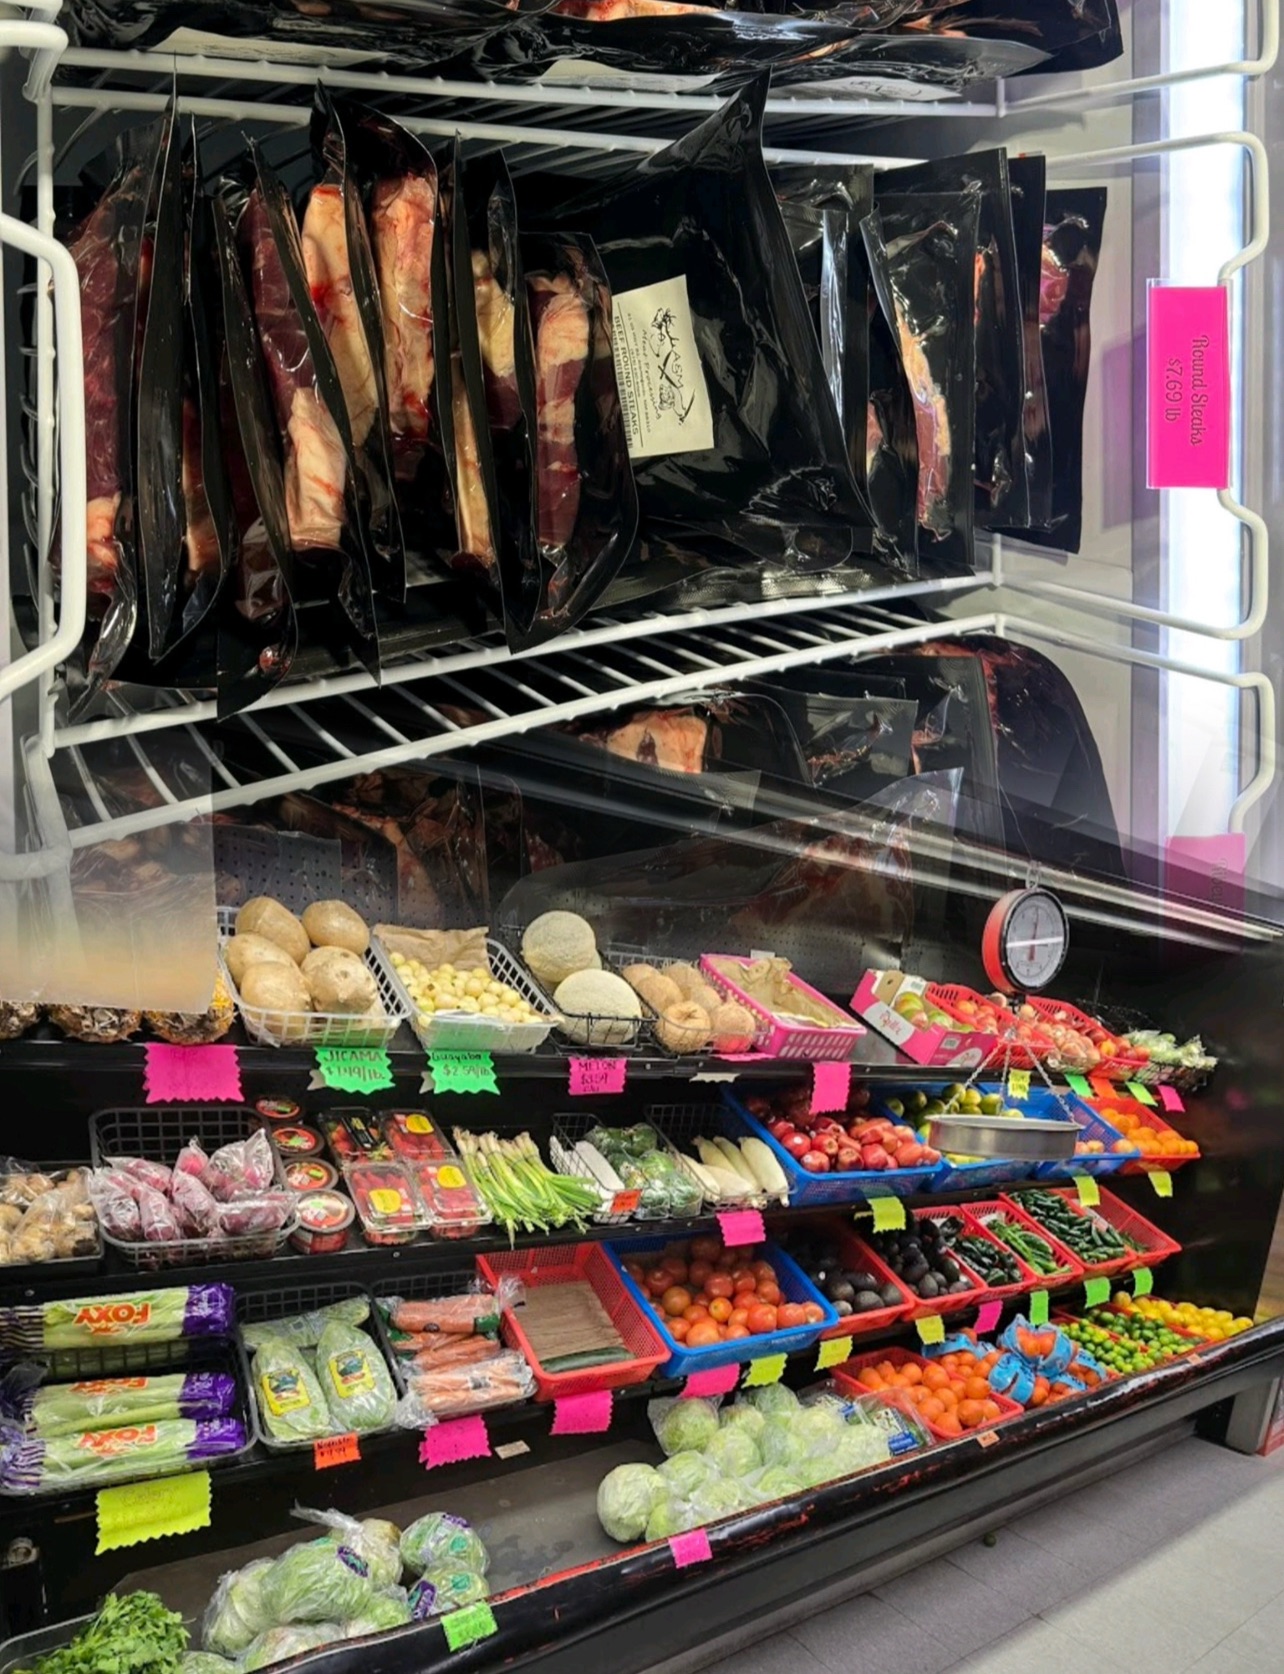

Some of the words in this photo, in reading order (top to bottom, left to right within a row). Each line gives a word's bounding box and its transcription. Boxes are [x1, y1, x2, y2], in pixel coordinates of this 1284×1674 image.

[614, 316, 625, 343] BEEF
[621, 347, 633, 388] ROUND
[627, 391, 639, 435] STEAKS
[1192, 335, 1210, 388] Round
[1165, 358, 1183, 402] $7.69
[1165, 408, 1182, 422] lb
[1190, 394, 1209, 446] Steaks
[323, 1050, 383, 1063] JICAMA
[73, 1302, 151, 1326] FOXY
[75, 1425, 157, 1448] FOXY
